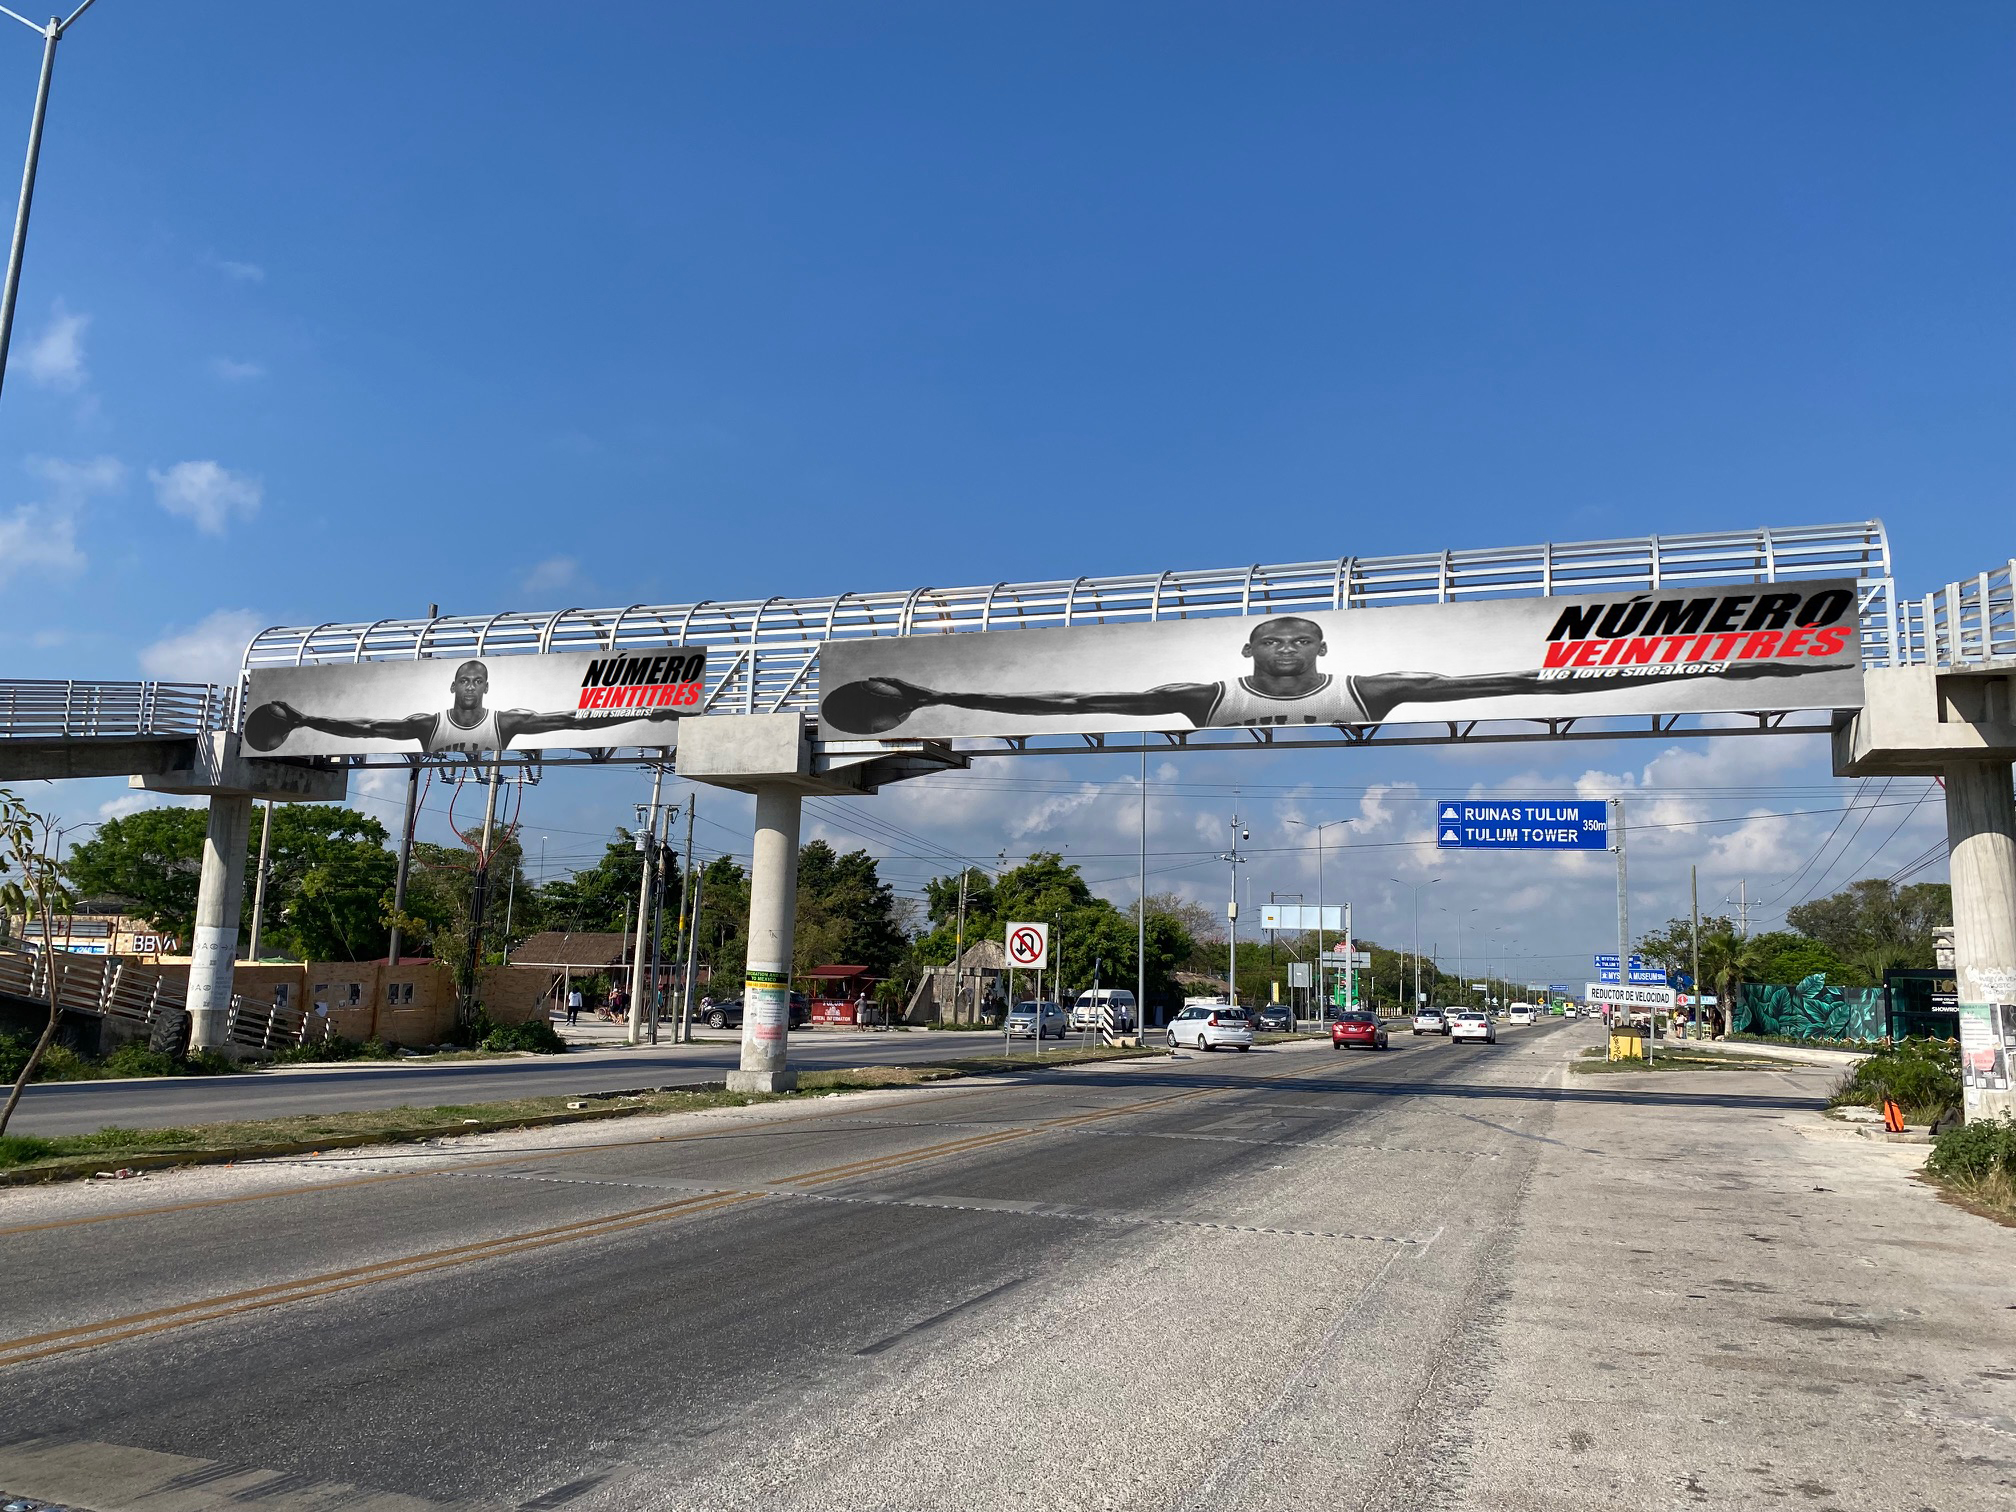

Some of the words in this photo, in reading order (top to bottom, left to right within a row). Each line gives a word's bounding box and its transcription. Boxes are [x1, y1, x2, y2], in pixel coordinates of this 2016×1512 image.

[1546, 589, 1854, 641] NÚMERO
[1542, 622, 1852, 668] VEINTITRÉS
[581, 653, 706, 687] NÚMERO
[1537, 667, 1567, 681] We
[1572, 664, 1617, 680] love
[1620, 660, 1731, 678] sneakers!
[578, 679, 703, 709] VEINTITRÉS
[575, 709, 588, 719] We
[590, 708, 608, 718] love
[609, 707, 654, 718] sneakers!
[1465, 808, 1521, 821] RUINAS
[1525, 808, 1579, 821] TULUM
[1582, 819, 1607, 831] 350m
[1465, 828, 1518, 841] TULUM
[1521, 829, 1579, 842] TOWER
[133, 935, 178, 952] BBVA
[1633, 972, 1658, 981] MUSEUM
[1592, 988, 1624, 1000] REDUCTOR
[1625, 991, 1634, 1000] DE
[1635, 991, 1670, 1003] VELOCIDAD
